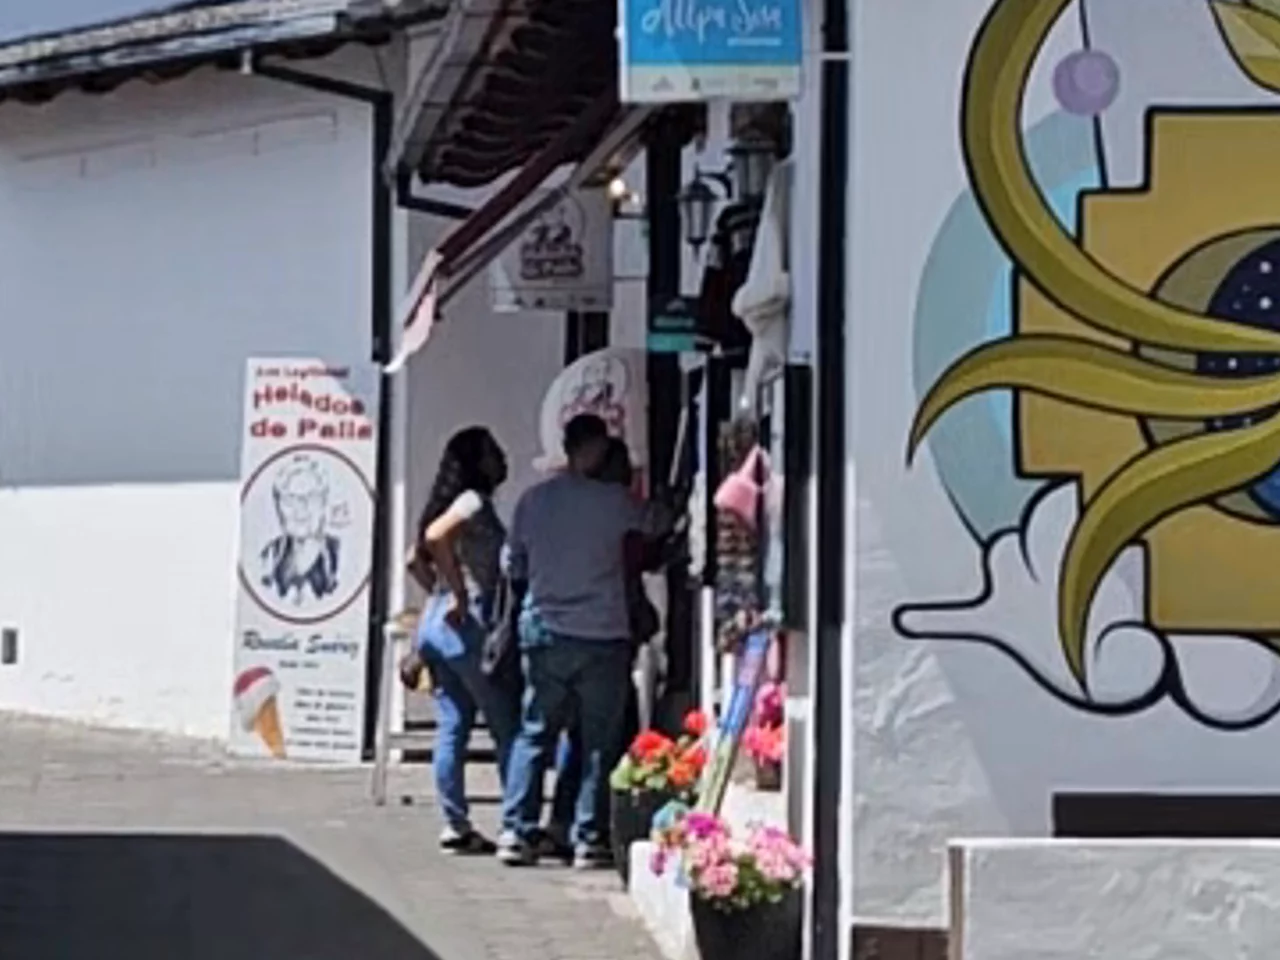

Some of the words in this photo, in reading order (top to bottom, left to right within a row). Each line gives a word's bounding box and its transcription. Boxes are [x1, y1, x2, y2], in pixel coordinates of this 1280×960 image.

[254, 383, 365, 415] Helados
[250, 419, 287, 438] de
[297, 418, 372, 440] Paila
